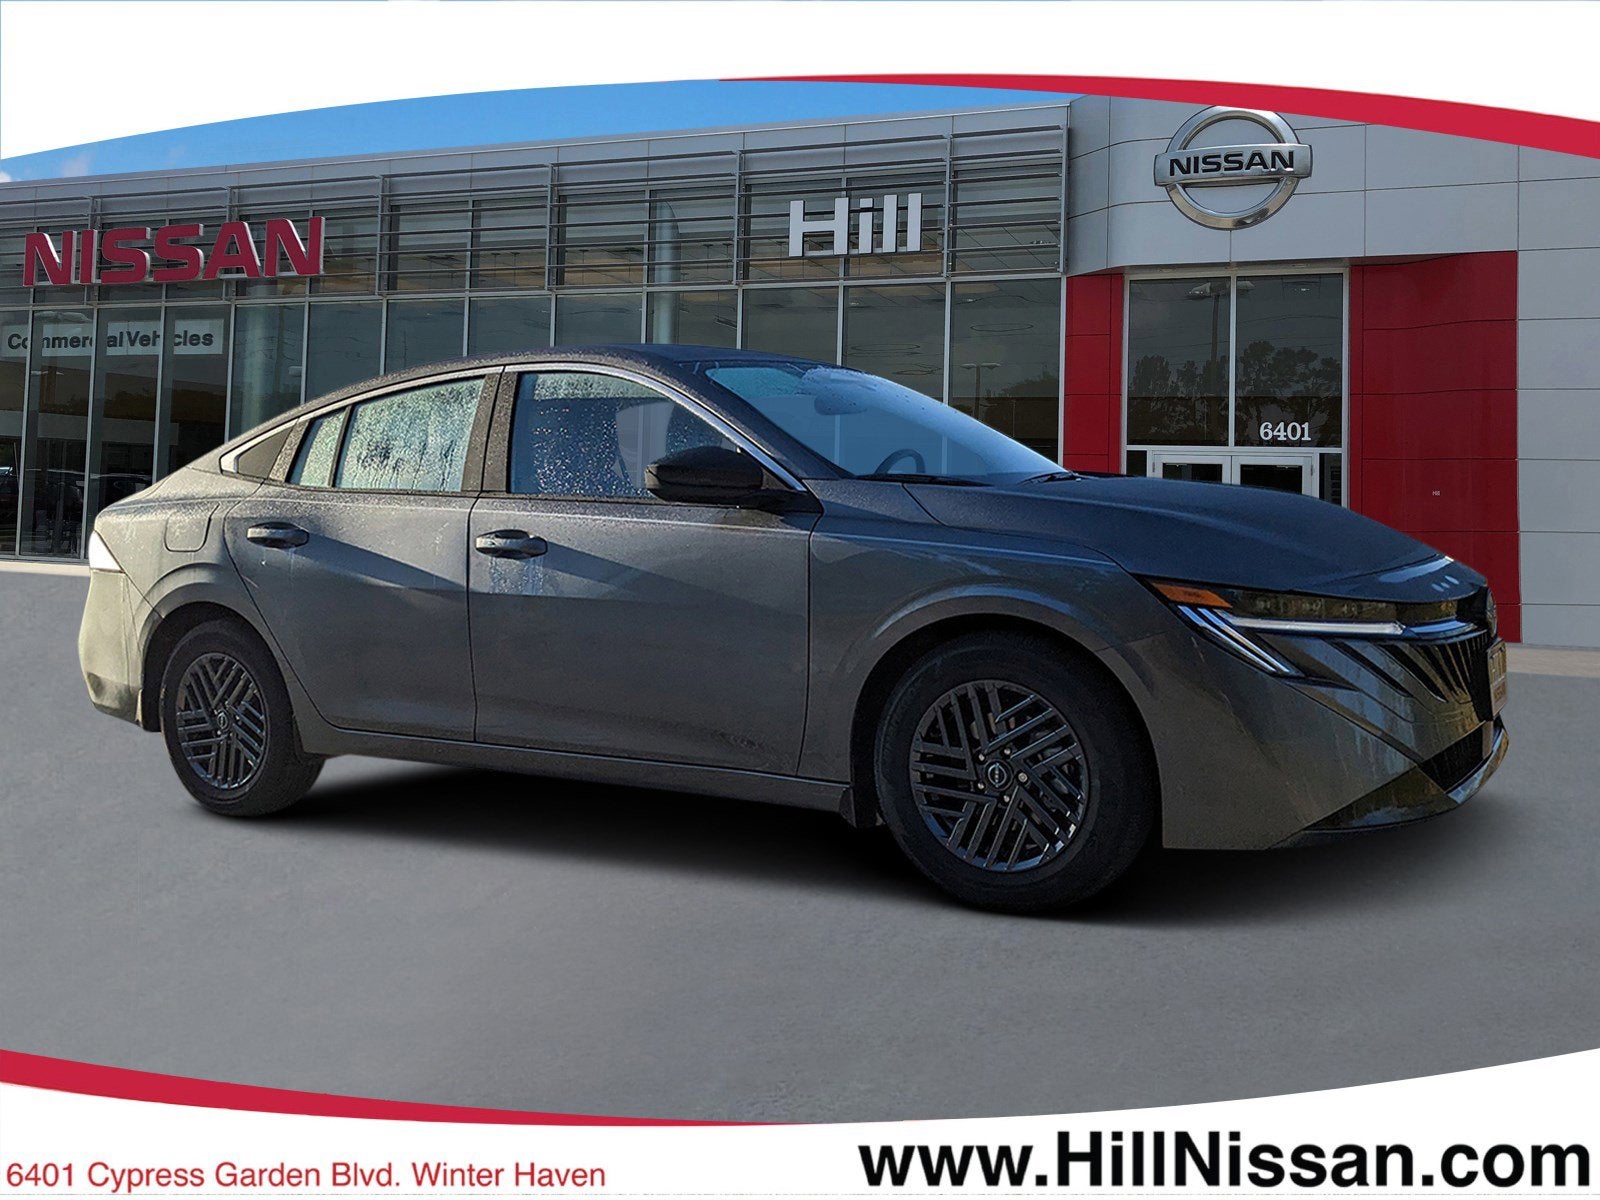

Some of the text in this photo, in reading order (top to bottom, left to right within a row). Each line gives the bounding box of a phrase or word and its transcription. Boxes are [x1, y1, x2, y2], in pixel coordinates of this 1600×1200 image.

[1169, 150, 1295, 177] NISSAN
[789, 193, 922, 257] Hill
[23, 216, 325, 287] NISSAN
[7, 330, 214, 350] Commeral Vehcles
[1259, 421, 1312, 441] 6401
